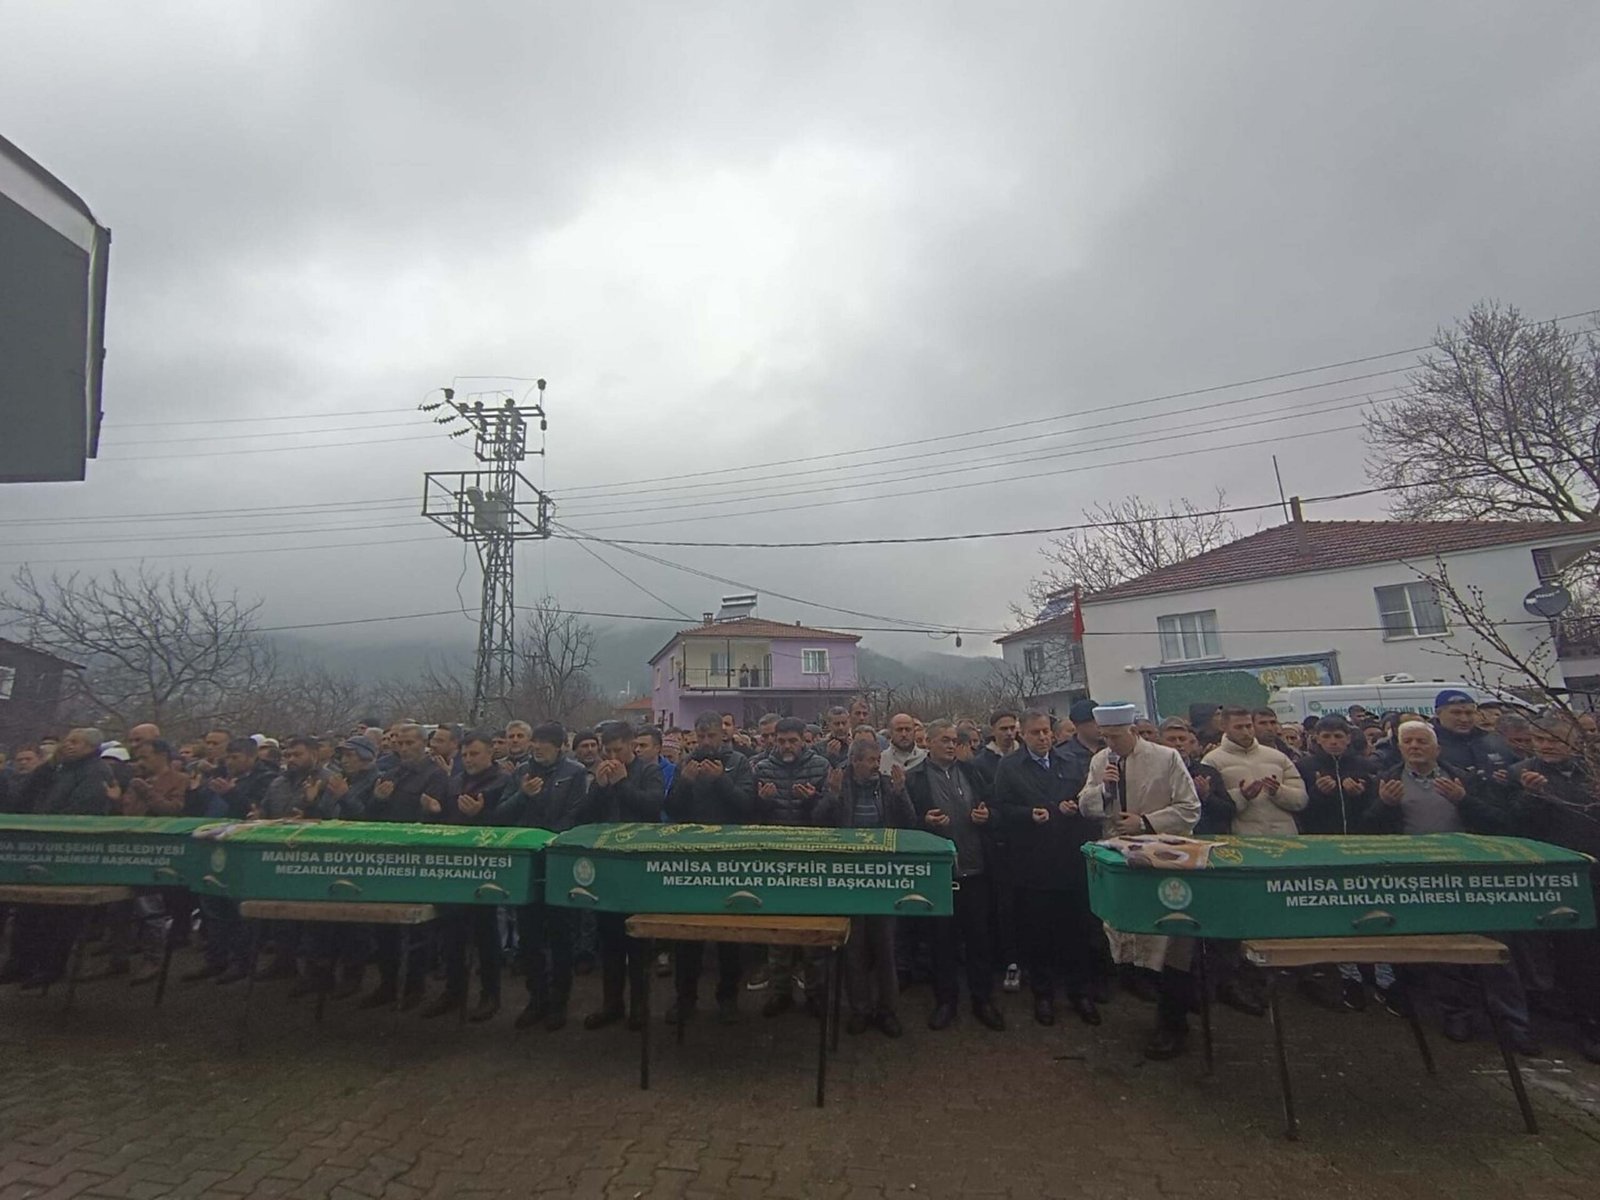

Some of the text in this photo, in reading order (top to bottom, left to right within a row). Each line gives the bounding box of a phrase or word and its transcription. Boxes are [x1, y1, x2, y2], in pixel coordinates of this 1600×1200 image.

[1321, 706, 1350, 716] MANİS
[108, 843, 184, 856] BELEDİYESİ
[102, 855, 170, 867] BAŞKANLIĞI
[261, 851, 512, 868] MANİSA BÜYÜKŞEHİR BELEDİYESİ
[275, 865, 497, 880] MEZARLIKLAR DAİRESİ BAŞKANLIĞI
[646, 859, 712, 873] MANİSA
[832, 861, 931, 876] BELEDİYESİ
[663, 875, 915, 890] MEZARLIKLAR DAİRESİ BAŞKANLIĞI
[1266, 872, 1579, 893] MANİSA BÜYÜKŞEHİR BELEDİYESİ
[1286, 889, 1561, 907] MEZARLIKLAR DAİRESİ BAŞKANLIĞI
